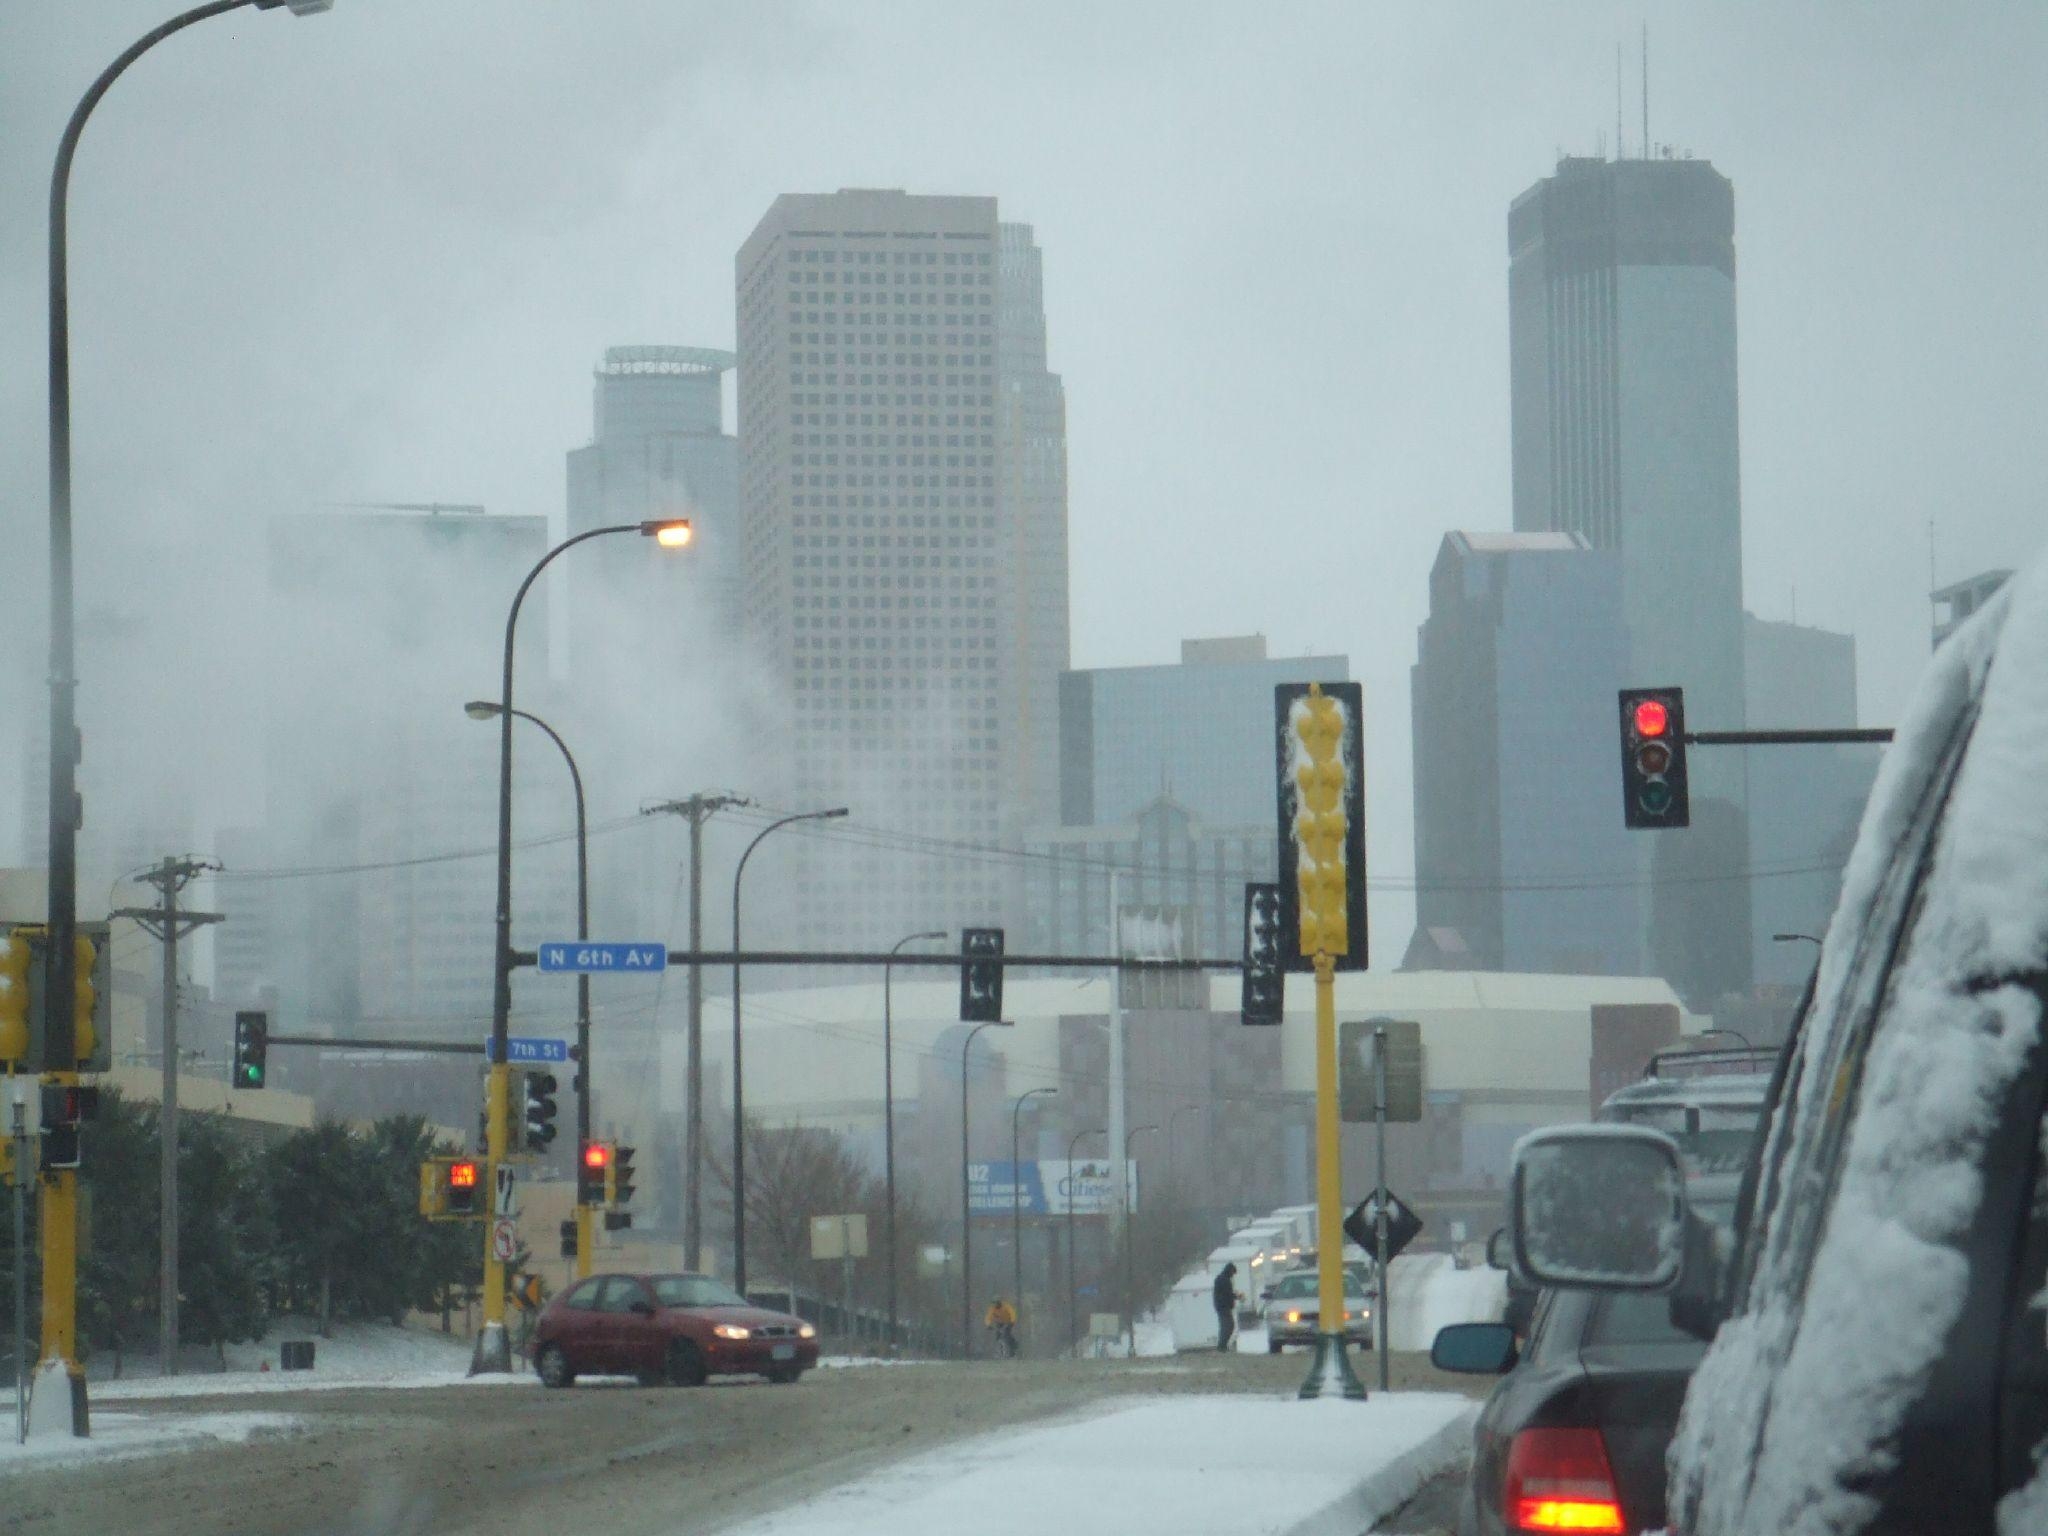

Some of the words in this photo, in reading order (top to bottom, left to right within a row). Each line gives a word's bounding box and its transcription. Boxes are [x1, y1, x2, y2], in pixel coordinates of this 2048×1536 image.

[550, 949, 565, 966] N
[577, 949, 613, 966] 6th
[625, 949, 654, 966] Av
[512, 1042, 537, 1057] 7th
[543, 1044, 559, 1058] St
